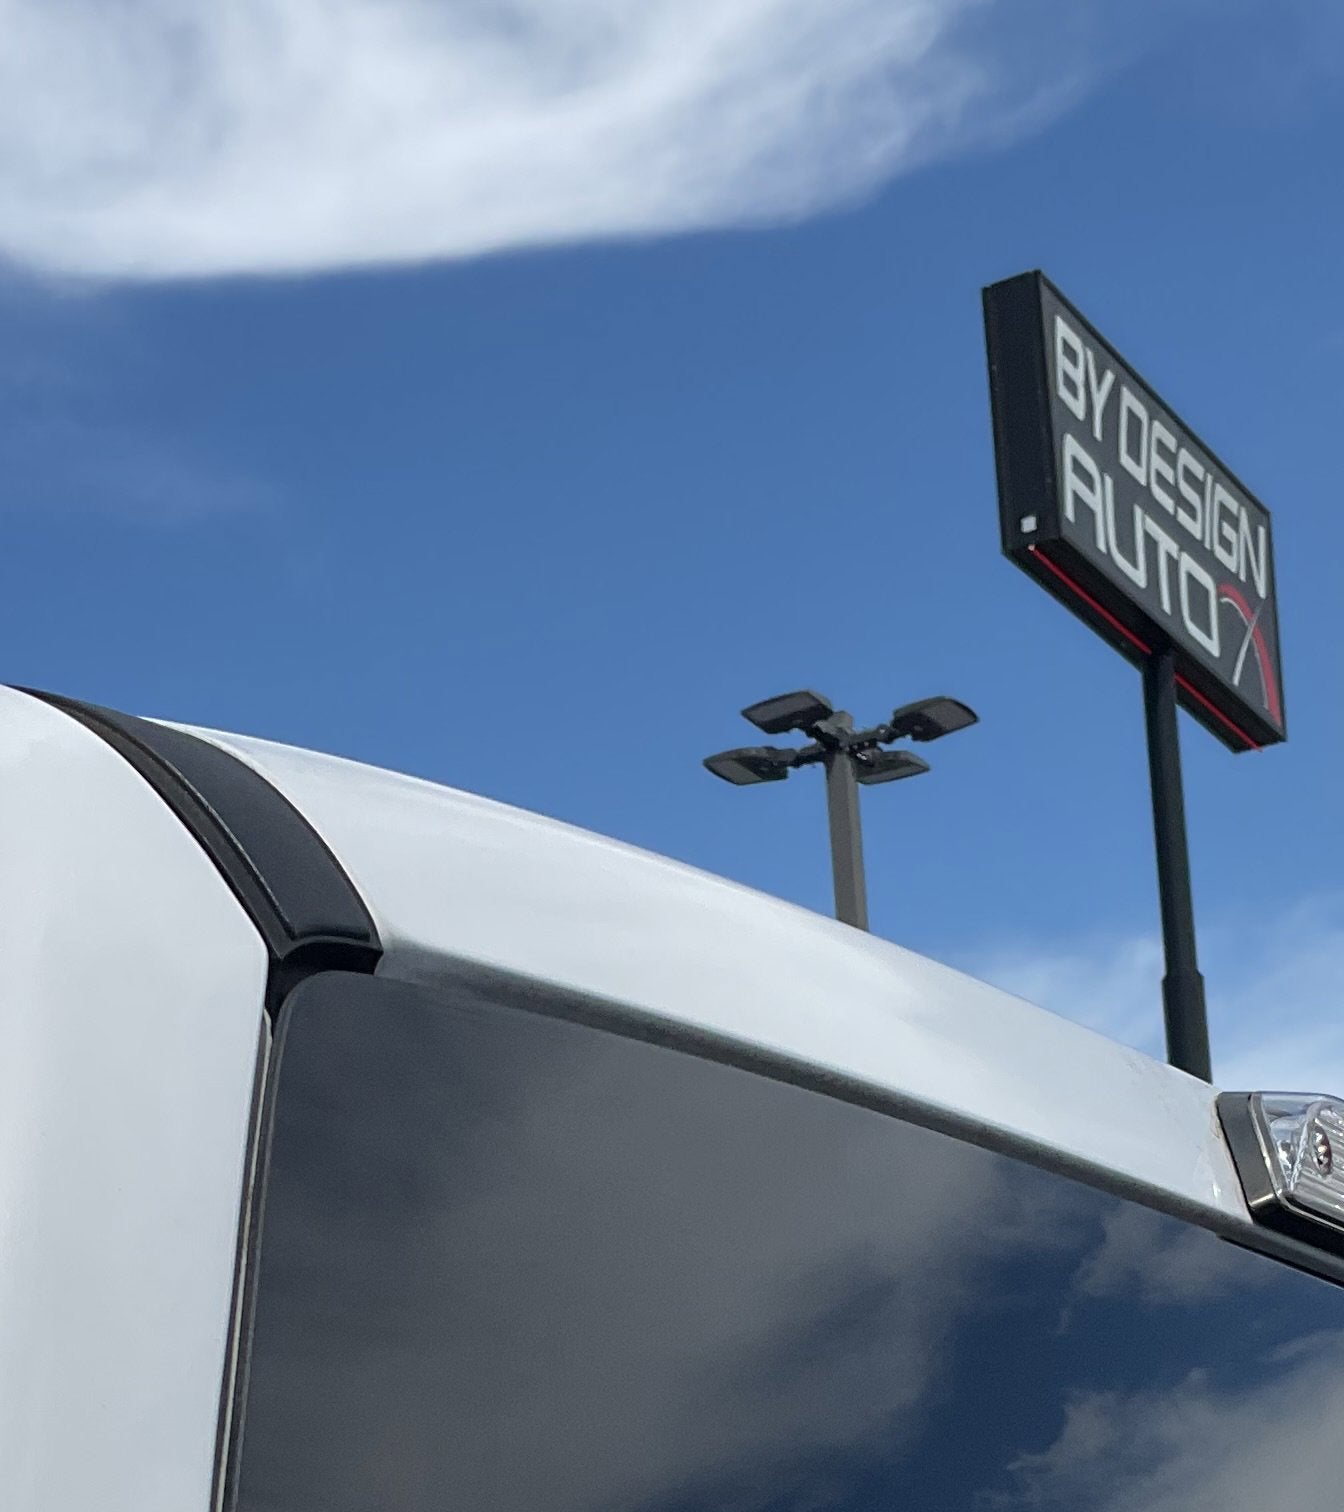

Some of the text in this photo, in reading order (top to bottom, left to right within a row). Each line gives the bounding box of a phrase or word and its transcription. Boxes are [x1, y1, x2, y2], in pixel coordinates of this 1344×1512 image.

[1056, 315, 1267, 600] BY DESIGN
[1063, 433, 1221, 658] AUTO
